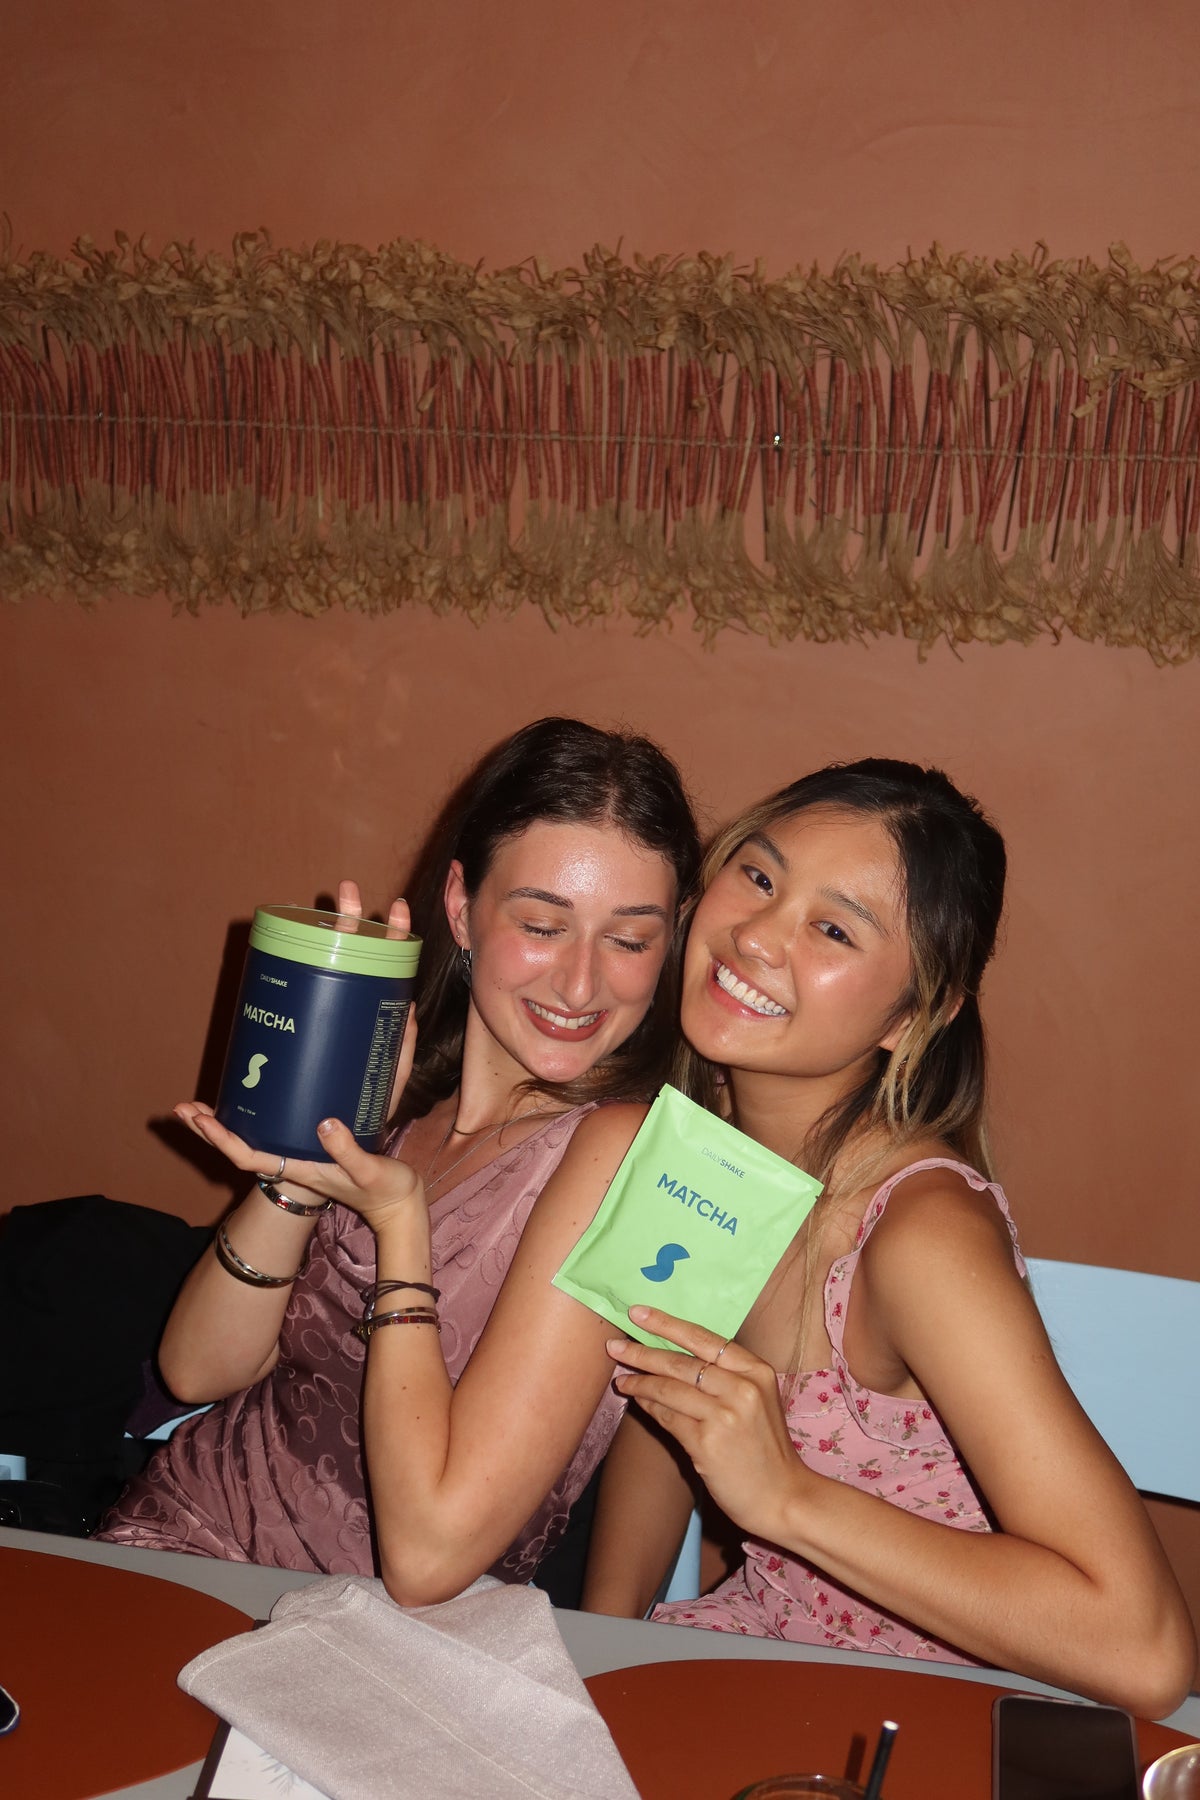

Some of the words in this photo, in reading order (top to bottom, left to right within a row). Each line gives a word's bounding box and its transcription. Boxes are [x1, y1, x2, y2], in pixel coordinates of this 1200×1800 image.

[243, 1002, 296, 1034] MATCHA
[701, 1147, 746, 1179] DAILYSHAKE
[656, 1172, 739, 1236] MATCHA
